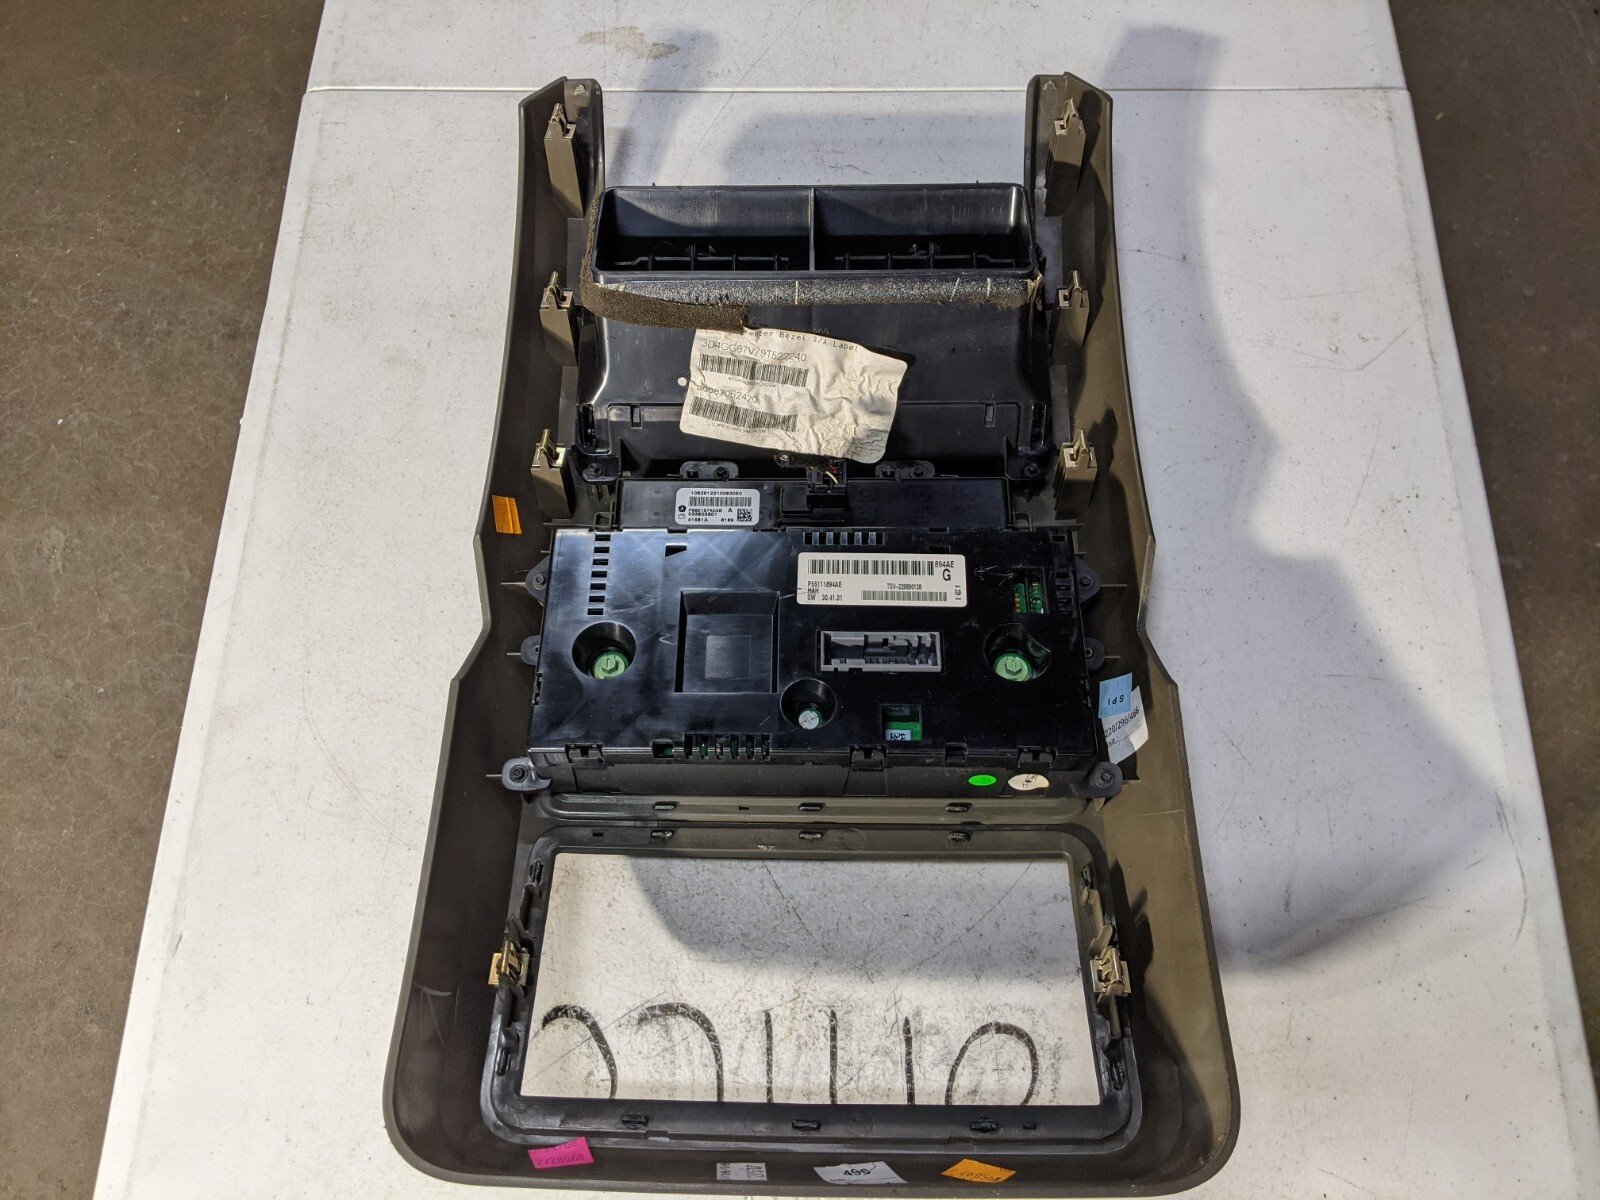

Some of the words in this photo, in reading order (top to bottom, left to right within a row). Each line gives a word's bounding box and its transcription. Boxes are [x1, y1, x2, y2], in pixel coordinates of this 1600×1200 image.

[779, 331, 806, 341] Bezel
[833, 340, 858, 352] Label
[935, 560, 954, 568] 894AE
[942, 568, 951, 581] G
